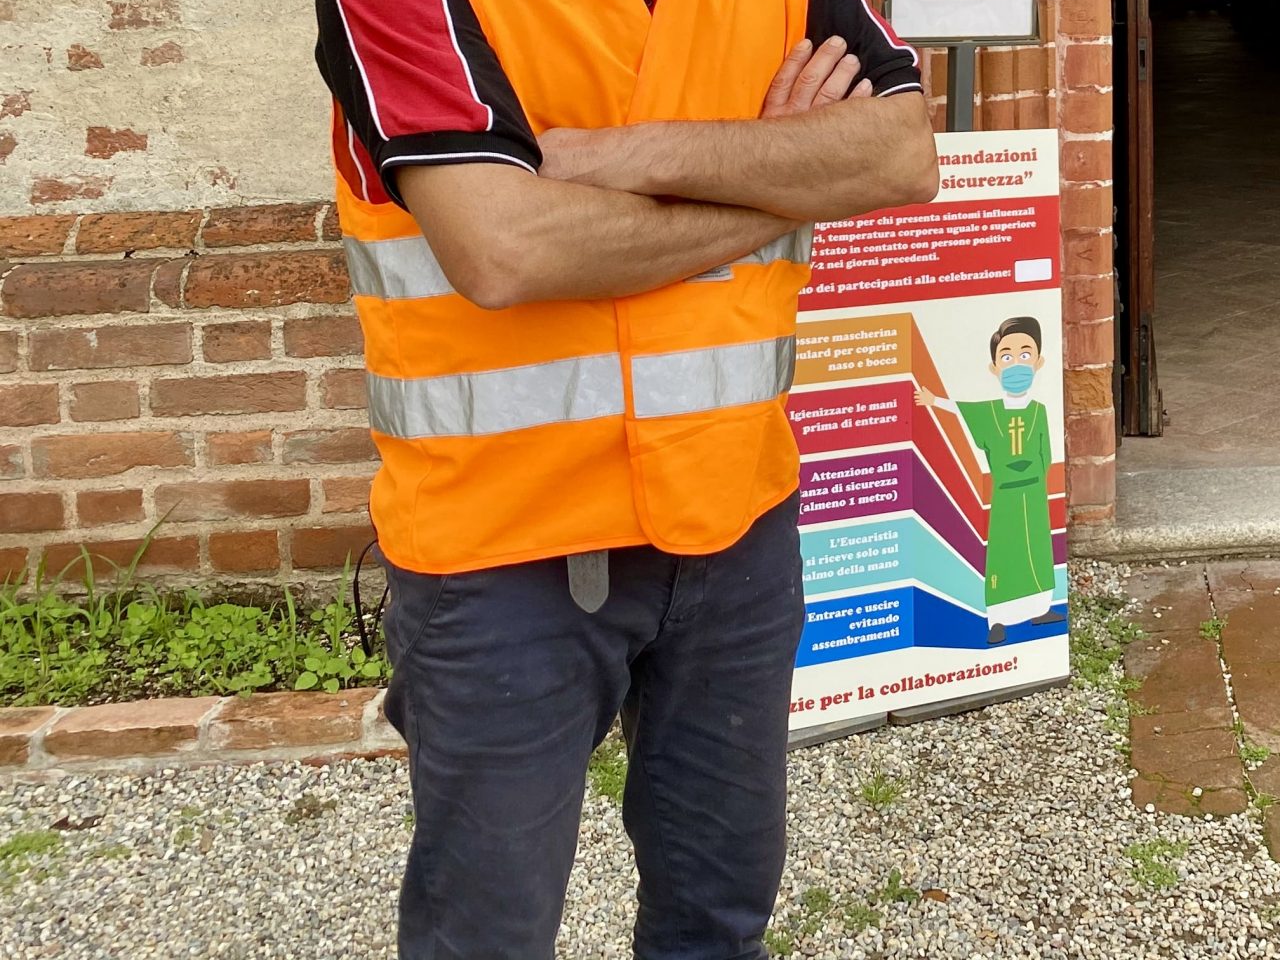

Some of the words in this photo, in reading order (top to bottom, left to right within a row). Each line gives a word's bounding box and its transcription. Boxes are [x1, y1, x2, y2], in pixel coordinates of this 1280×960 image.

[938, 148, 1038, 166] mandazioni
[941, 171, 1033, 190] sicurezza”
[856, 218, 874, 229] per
[876, 215, 894, 226] chi
[896, 213, 940, 227] presenta
[942, 210, 981, 221] sintomi
[983, 206, 1035, 219] influenzali
[828, 229, 896, 243] temperatura
[898, 226, 944, 240] corporea
[946, 223, 980, 236] uguale
[990, 220, 1036, 234] superiore
[819, 247, 848, 256] stato
[850, 245, 861, 254] in
[863, 242, 908, 253] contatto
[910, 241, 929, 250] con
[931, 237, 971, 250] persone
[972, 234, 1012, 247] positive
[827, 259, 844, 269] nei
[846, 257, 879, 270] giorni
[881, 253, 940, 267] precedenti.
[816, 283, 835, 294] dei
[837, 275, 912, 294] partecipanti
[914, 273, 936, 285] alla
[938, 269, 1011, 283] celebrazione:
[832, 328, 897, 342] mascherina
[834, 347, 853, 358] per
[856, 342, 897, 355] coprire
[828, 361, 855, 371] naso
[866, 356, 897, 367] bocca
[790, 405, 854, 422] Igienizzare
[856, 403, 867, 412] le
[869, 398, 897, 411] mani
[802, 421, 838, 435] prima
[841, 418, 853, 429] di
[855, 415, 898, 427] entrare
[811, 466, 874, 482] Attenzione
[877, 462, 898, 472] alla
[800, 487, 828, 498] anza
[831, 483, 843, 494] di
[845, 477, 898, 492] sicurezza
[799, 498, 846, 515] (almeno
[849, 497, 856, 506] 1
[858, 490, 898, 505] metro)
[806, 556, 816, 566] si
[818, 551, 854, 565] riceve
[856, 547, 879, 559] solo
[882, 544, 898, 555] sul
[836, 564, 865, 576] della
[868, 559, 899, 571] mano
[807, 607, 854, 623] Entrare
[856, 606, 863, 614] e
[864, 599, 899, 613] uscire
[849, 613, 900, 630] evitando
[812, 627, 900, 651] assembramenti
[819, 690, 852, 710] per
[858, 686, 875, 700] la
[880, 656, 1018, 697] collaborazione!
